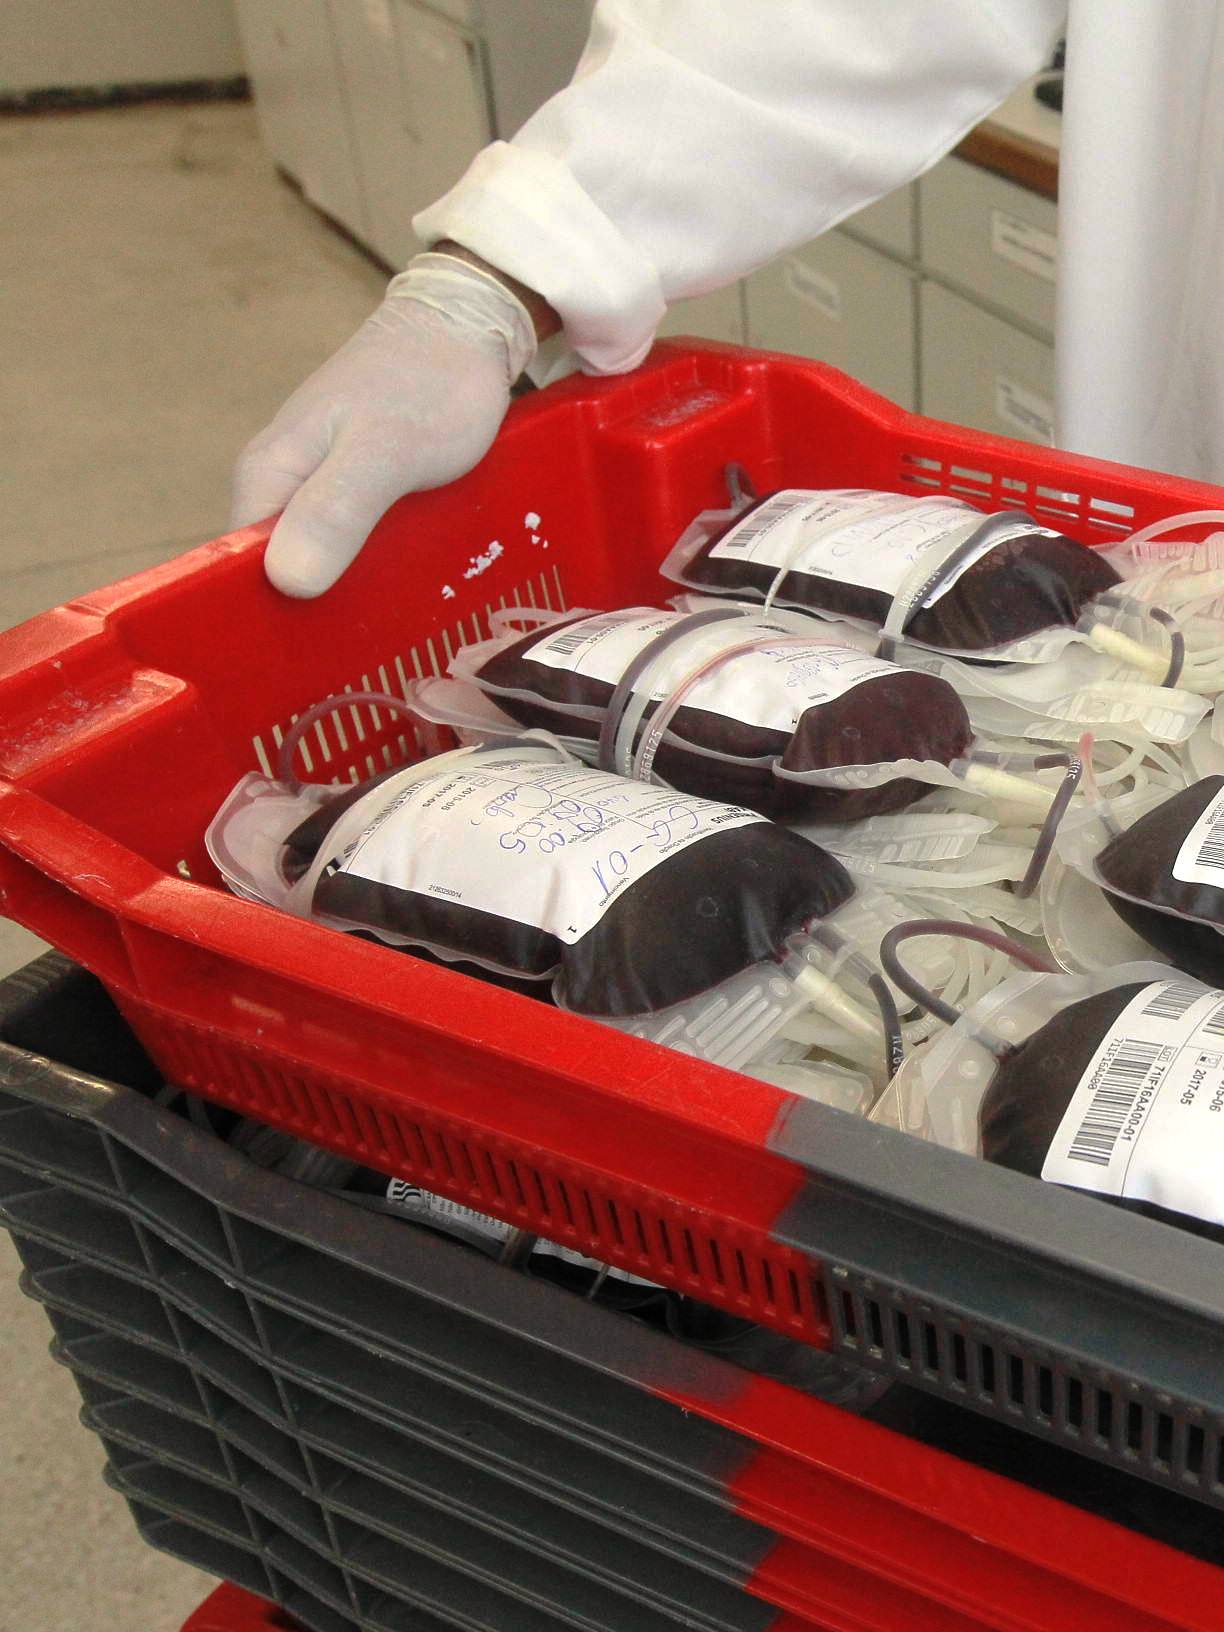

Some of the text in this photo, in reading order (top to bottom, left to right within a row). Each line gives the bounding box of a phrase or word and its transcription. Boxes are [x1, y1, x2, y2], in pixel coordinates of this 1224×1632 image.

[567, 924, 577, 934] 1
[1120, 1063, 1165, 1142] 71IF16AA00-01
[1179, 1068, 1206, 1106] 2017-05
